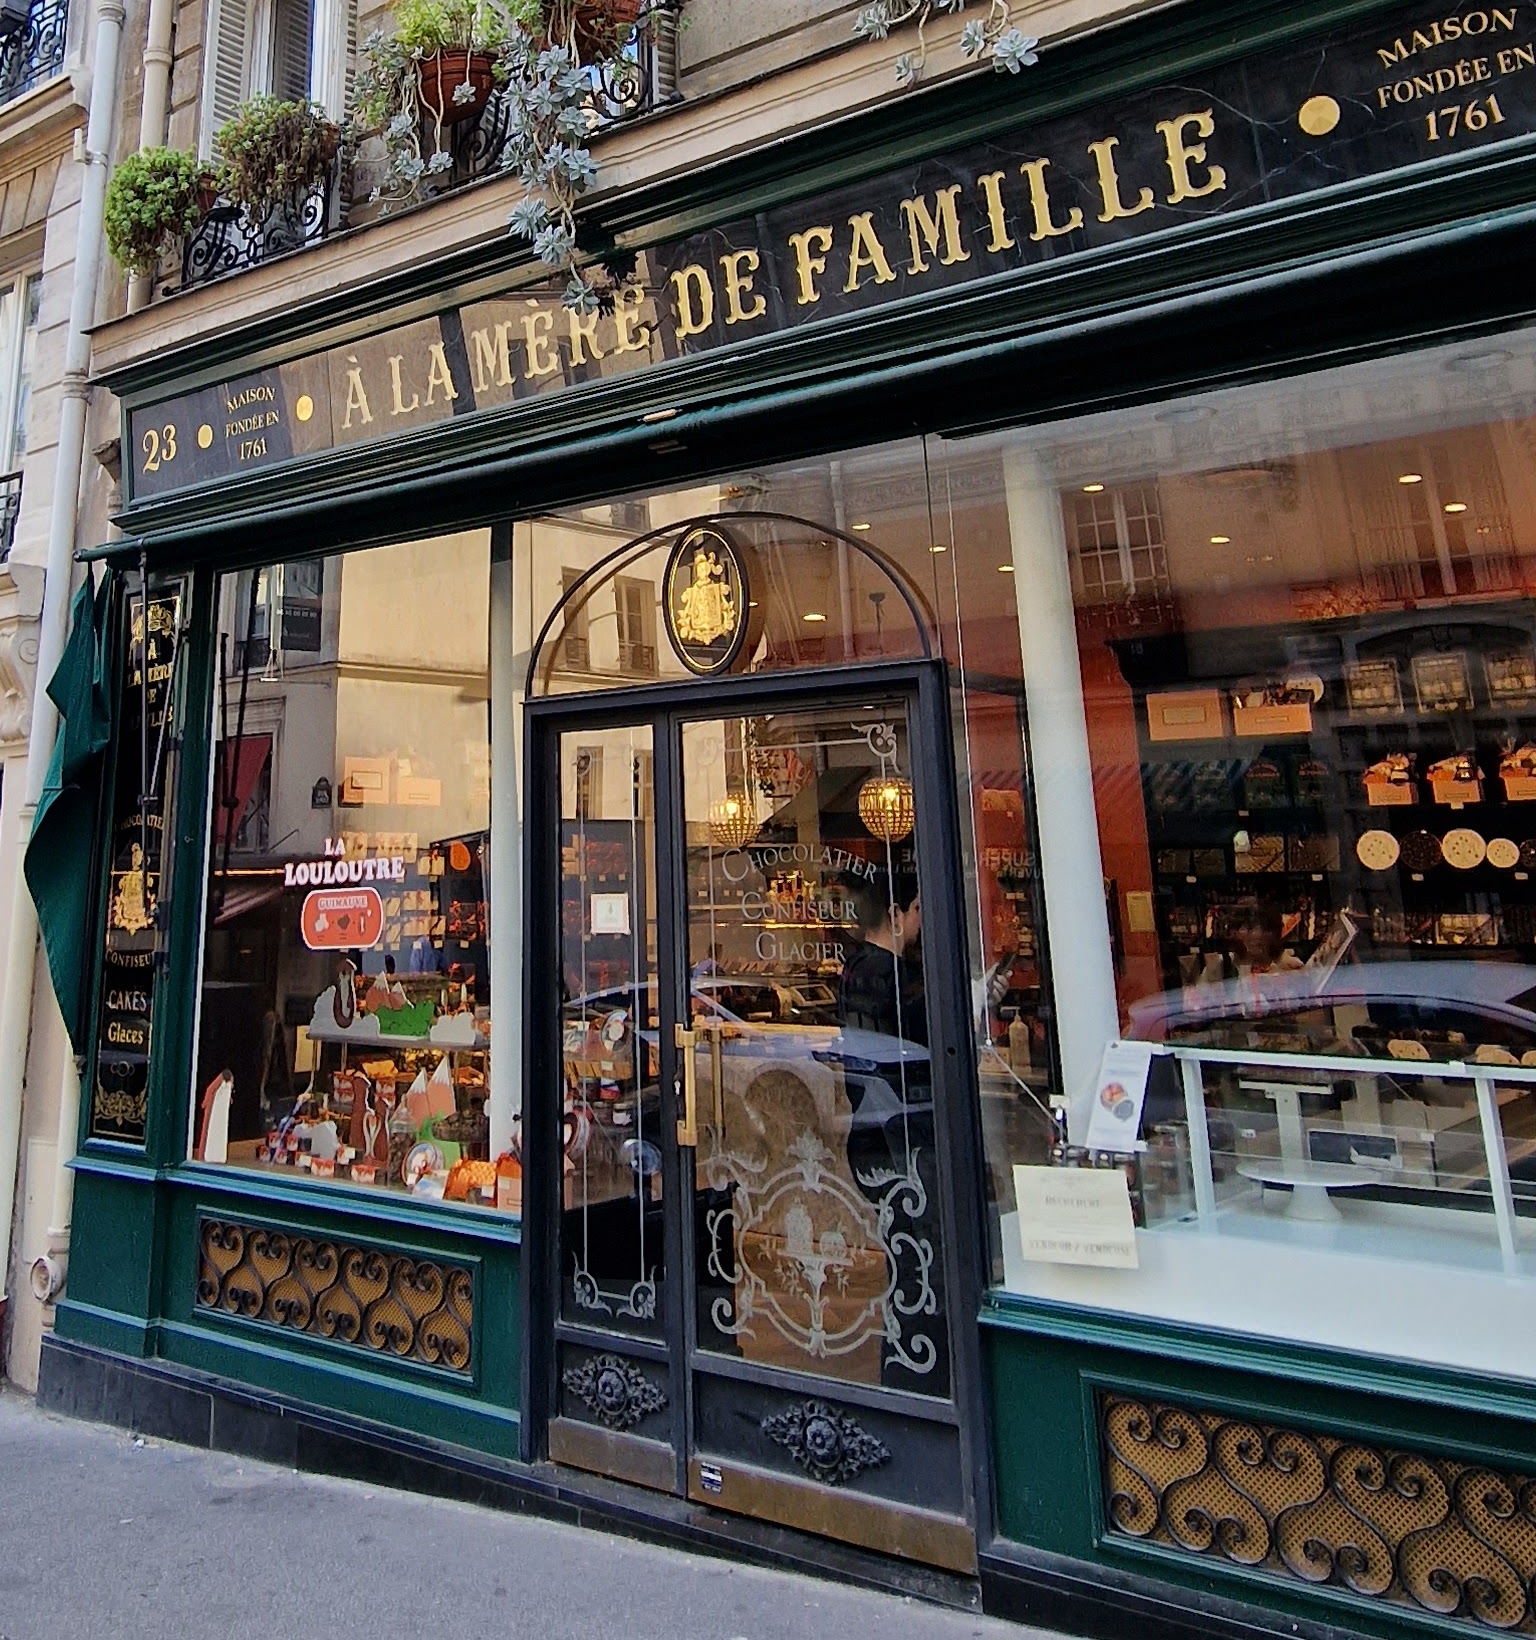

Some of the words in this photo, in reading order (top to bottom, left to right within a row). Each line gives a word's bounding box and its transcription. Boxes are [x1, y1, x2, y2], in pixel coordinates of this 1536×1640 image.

[1376, 8, 1517, 69] MAISON
[1377, 57, 1492, 108] FONDÉE
[1496, 42, 1536, 75] EN
[1425, 93, 1506, 141] 1761
[341, 355, 374, 429] À
[387, 340, 459, 416] LA
[471, 283, 651, 394] MÈRE
[670, 247, 767, 340] DE
[788, 108, 1227, 307] FAMILLE
[226, 386, 276, 414] MAISON
[225, 412, 264, 439] FONDÉE
[265, 410, 280, 426] EN
[142, 424, 177, 474] 23
[239, 437, 268, 460] 1761
[324, 837, 346, 856] LA
[284, 856, 406, 886] LOULOUTRE
[756, 931, 847, 962] GLACIER
[108, 990, 147, 1012] CAKES
[108, 1021, 144, 1045] Glaces
